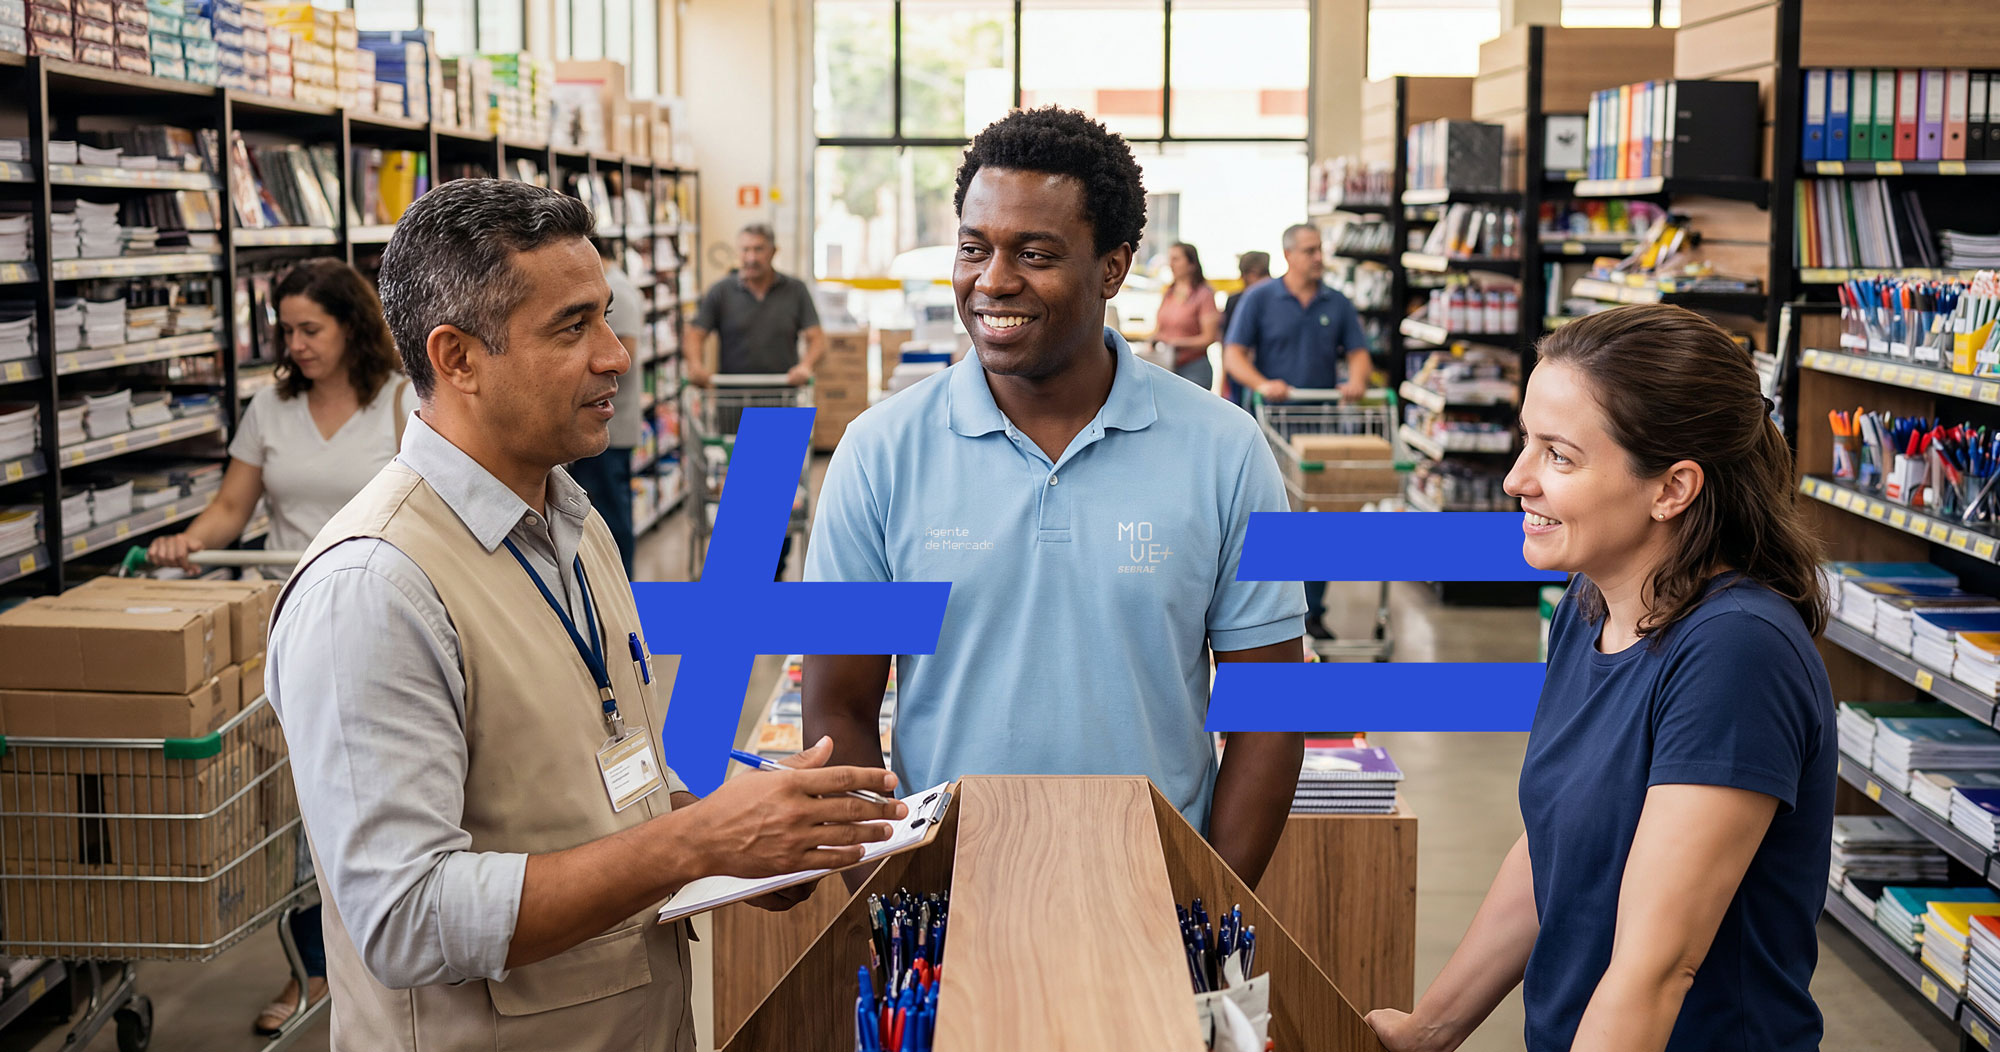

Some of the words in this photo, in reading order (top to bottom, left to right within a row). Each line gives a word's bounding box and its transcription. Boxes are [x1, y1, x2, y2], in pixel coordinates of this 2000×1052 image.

[925, 527, 969, 538] Agente
[1118, 521, 1152, 541] MO
[925, 540, 940, 550] de
[942, 540, 994, 550] Mercado
[1118, 565, 1157, 574] SEBRAE
